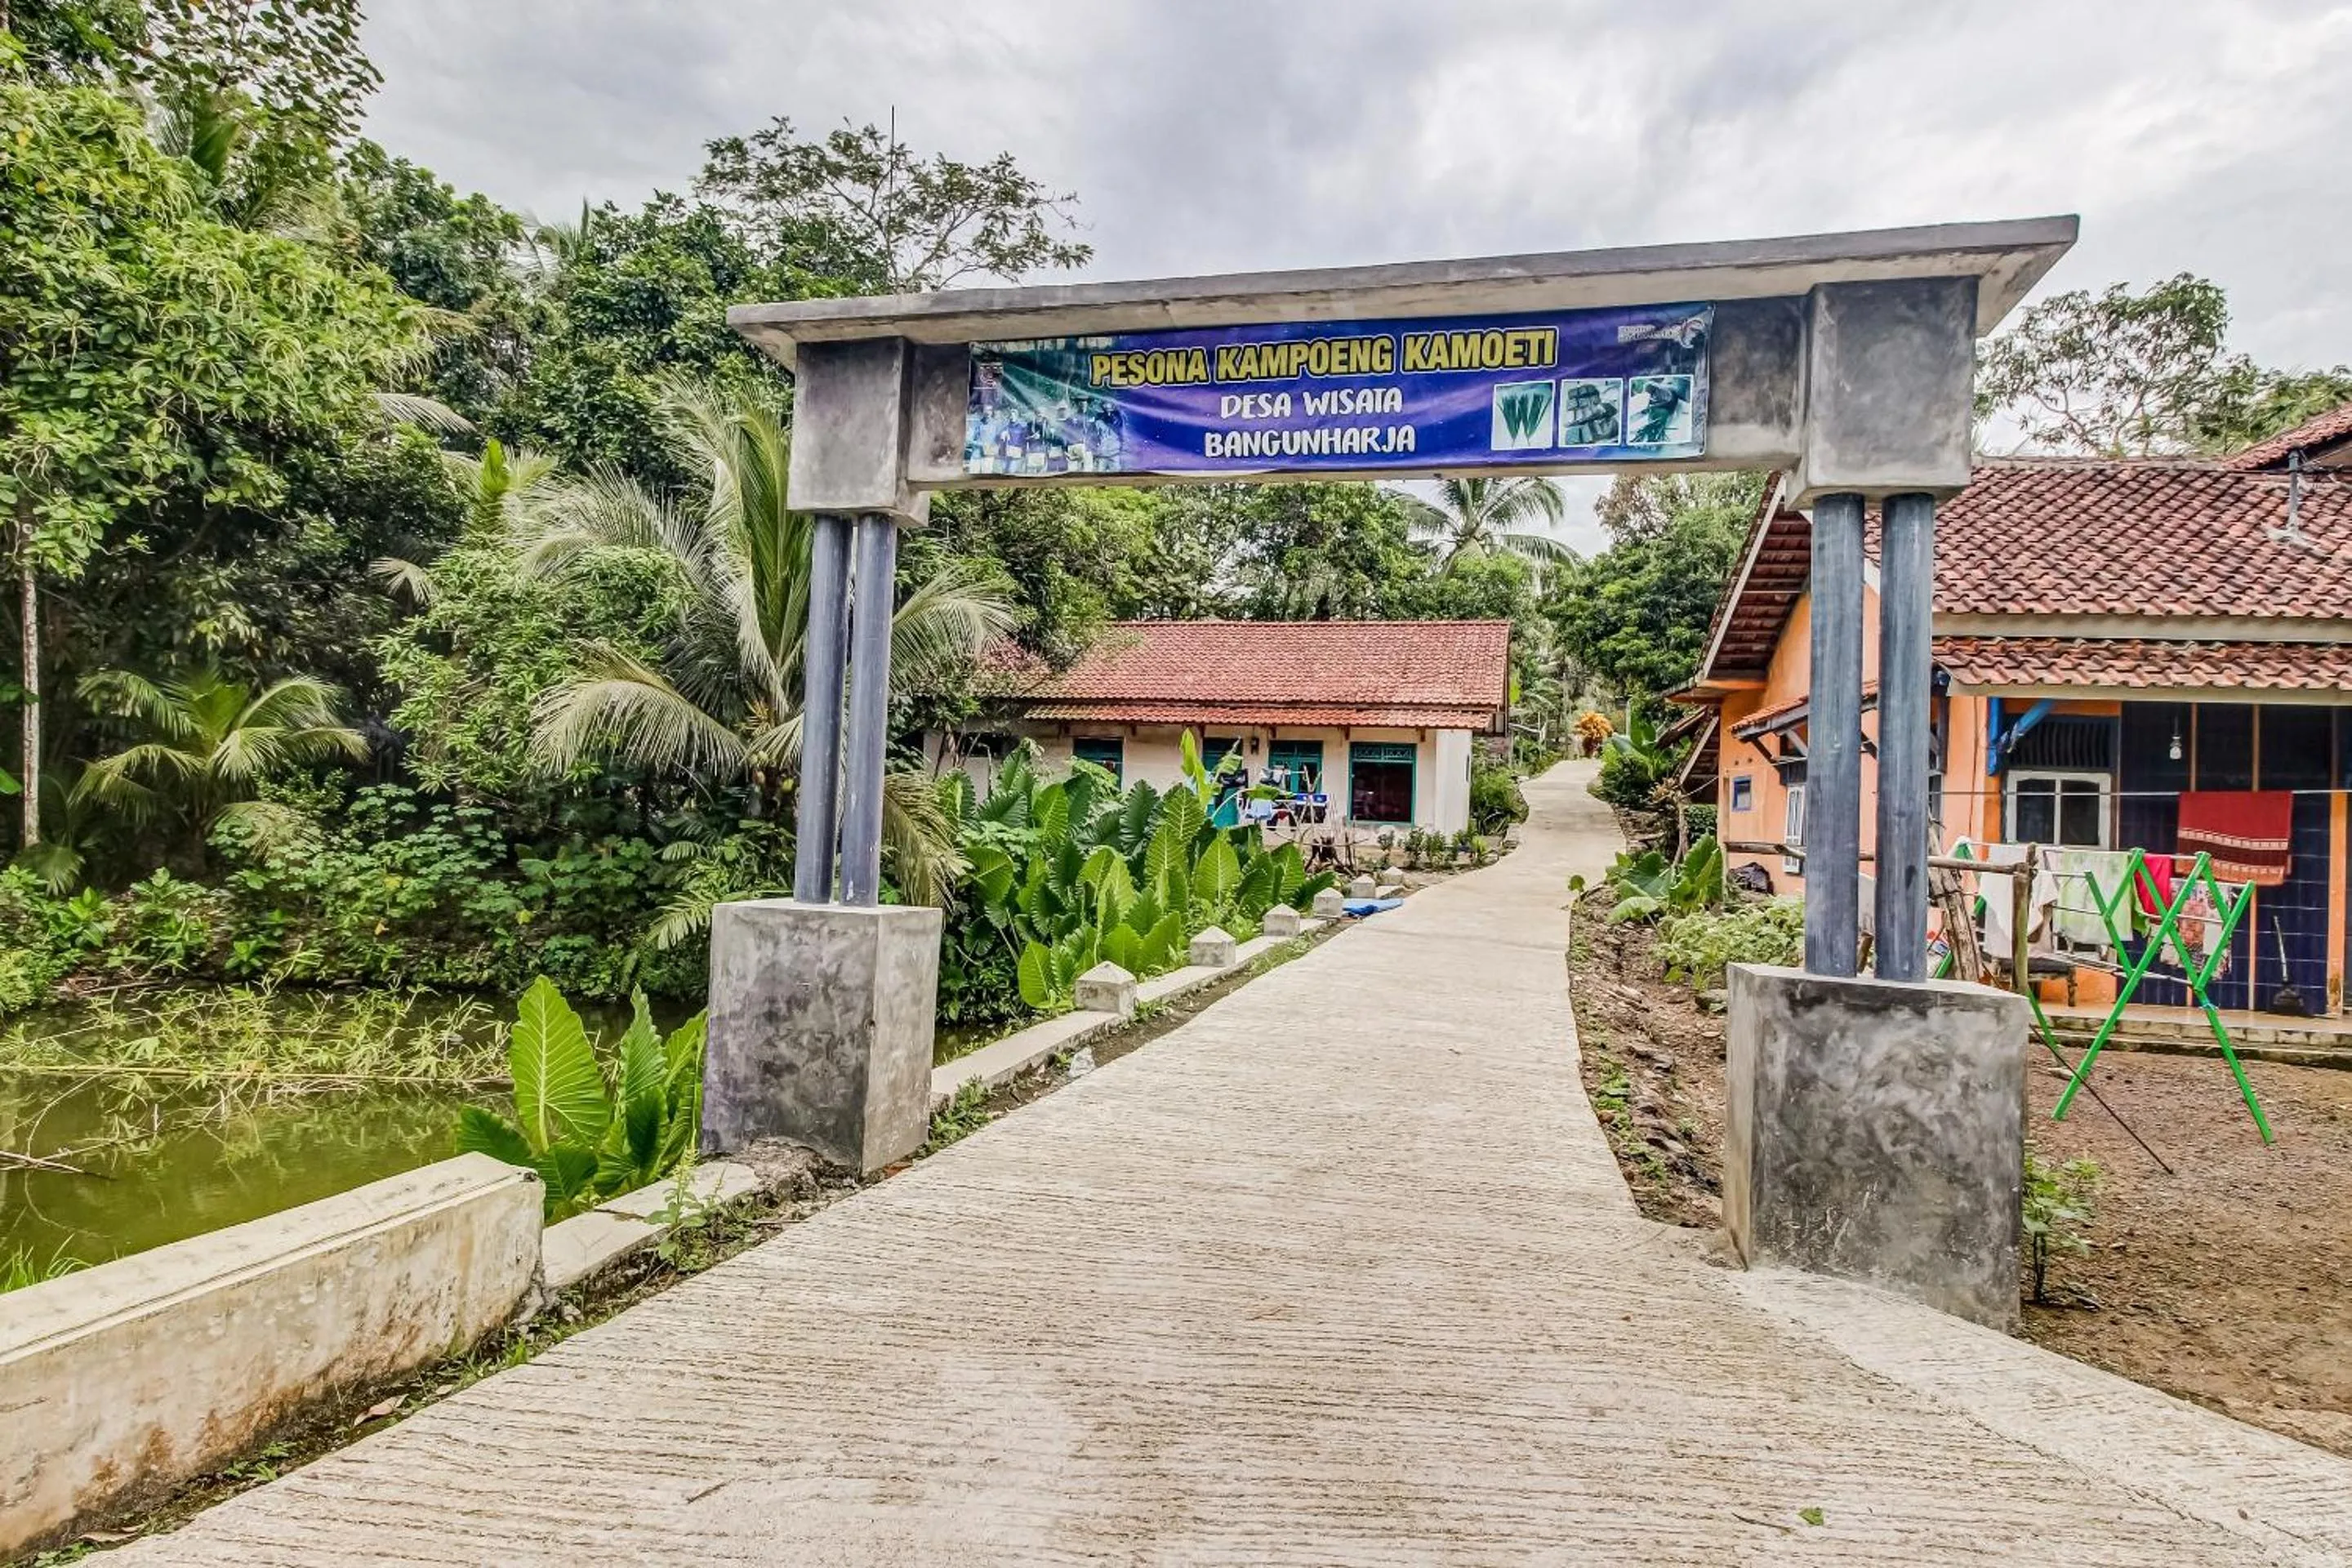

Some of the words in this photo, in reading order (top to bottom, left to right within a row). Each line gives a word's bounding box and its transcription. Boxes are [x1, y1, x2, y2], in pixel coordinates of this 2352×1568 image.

[1090, 349, 1209, 388] PESONA
[1216, 336, 1394, 382] KAMPOENG
[1402, 327, 1557, 372] KAMOETI
[1220, 392, 1291, 419] DESA
[1303, 387, 1403, 416] WISATA
[1204, 424, 1416, 457] BANGUNHARJA
